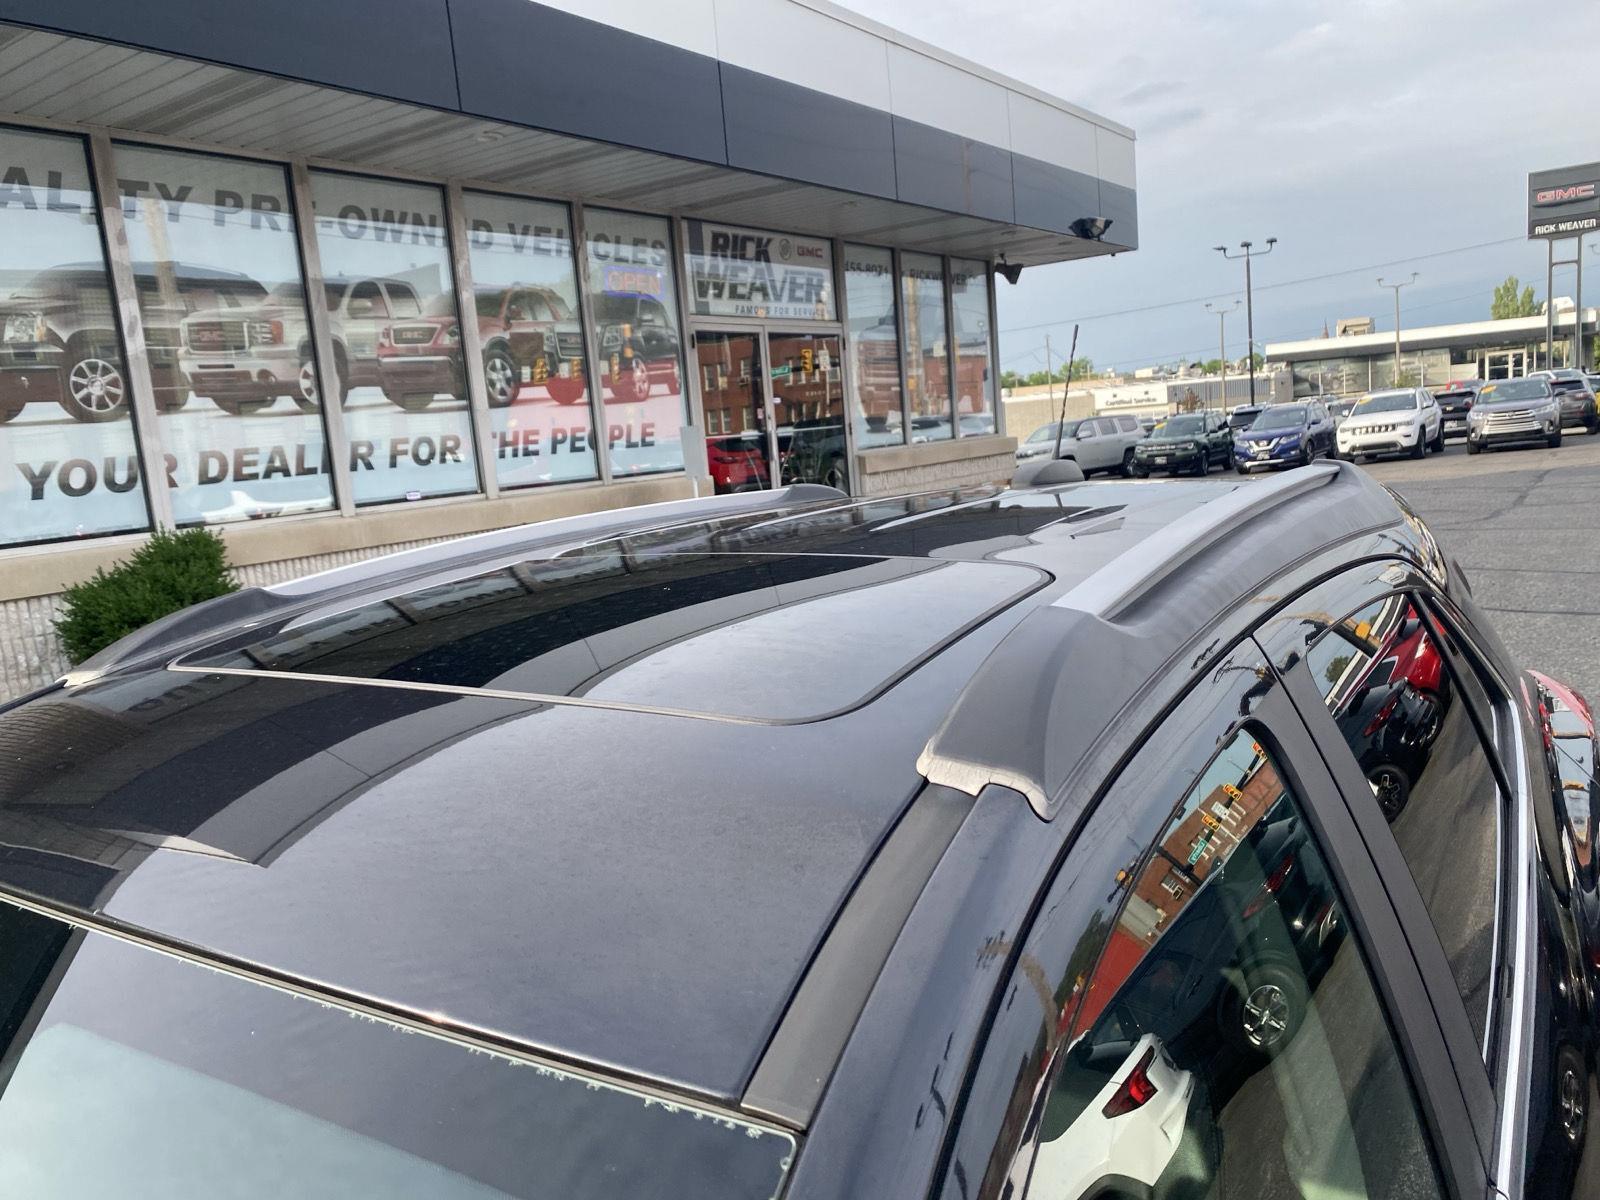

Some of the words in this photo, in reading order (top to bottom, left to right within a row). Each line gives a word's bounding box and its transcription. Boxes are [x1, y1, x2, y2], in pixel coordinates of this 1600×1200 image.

[1536, 184, 1595, 203] GMC
[0, 166, 193, 223] ALTY
[507, 222, 666, 267] VEHCLES
[1535, 223, 1556, 235] RICK
[1558, 218, 1597, 232] WEAVER
[710, 230, 773, 263] RICK
[796, 246, 823, 258] GMC
[608, 271, 660, 295] OPEN
[695, 262, 825, 303] WEAVER
[774, 306, 790, 315] FOR
[15, 453, 179, 500] YOUR
[389, 434, 462, 468] FOR
[491, 429, 540, 459] HE
